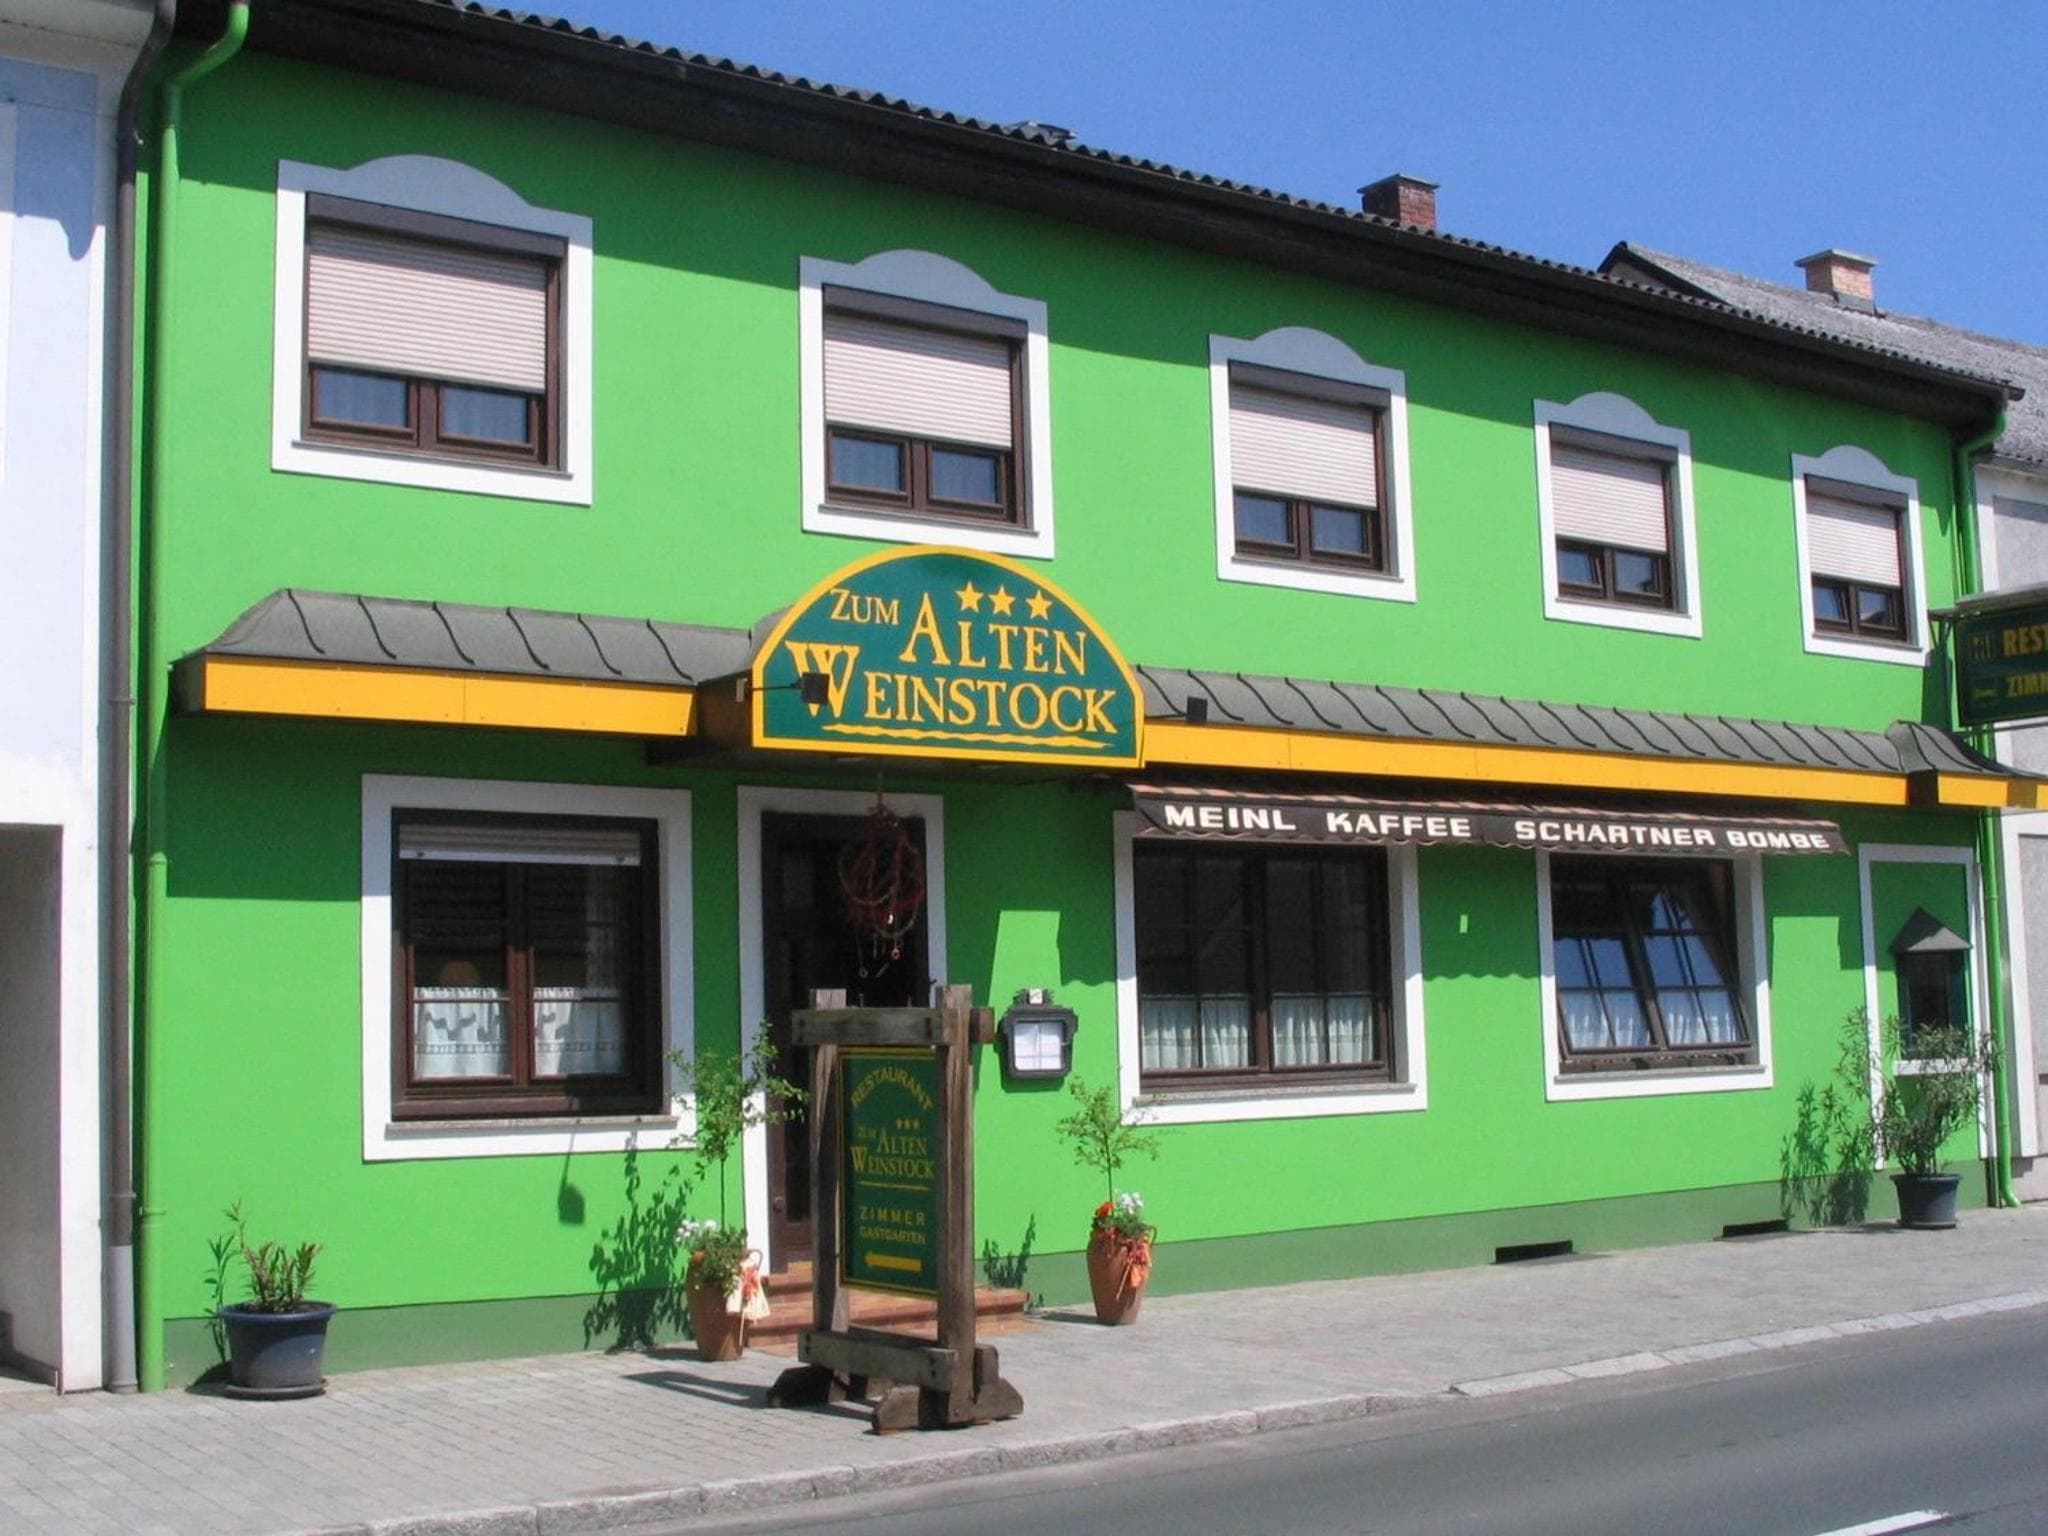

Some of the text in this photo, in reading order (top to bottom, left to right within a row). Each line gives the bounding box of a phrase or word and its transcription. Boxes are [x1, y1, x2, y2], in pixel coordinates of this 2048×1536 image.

[830, 588, 1086, 676] ZUM ALTEN
[785, 640, 1118, 735] WEINSTOCK
[1164, 804, 1831, 849] MEINL KAFFEE SCHARTNER BOMBE
[851, 1066, 934, 1110] RESTAURANT
[876, 1127, 928, 1156] ALTEN
[850, 1146, 935, 1179] WEINSTOCK
[860, 1206, 926, 1226] ZIMMER
[859, 1226, 927, 1245] GASTGARTEN
